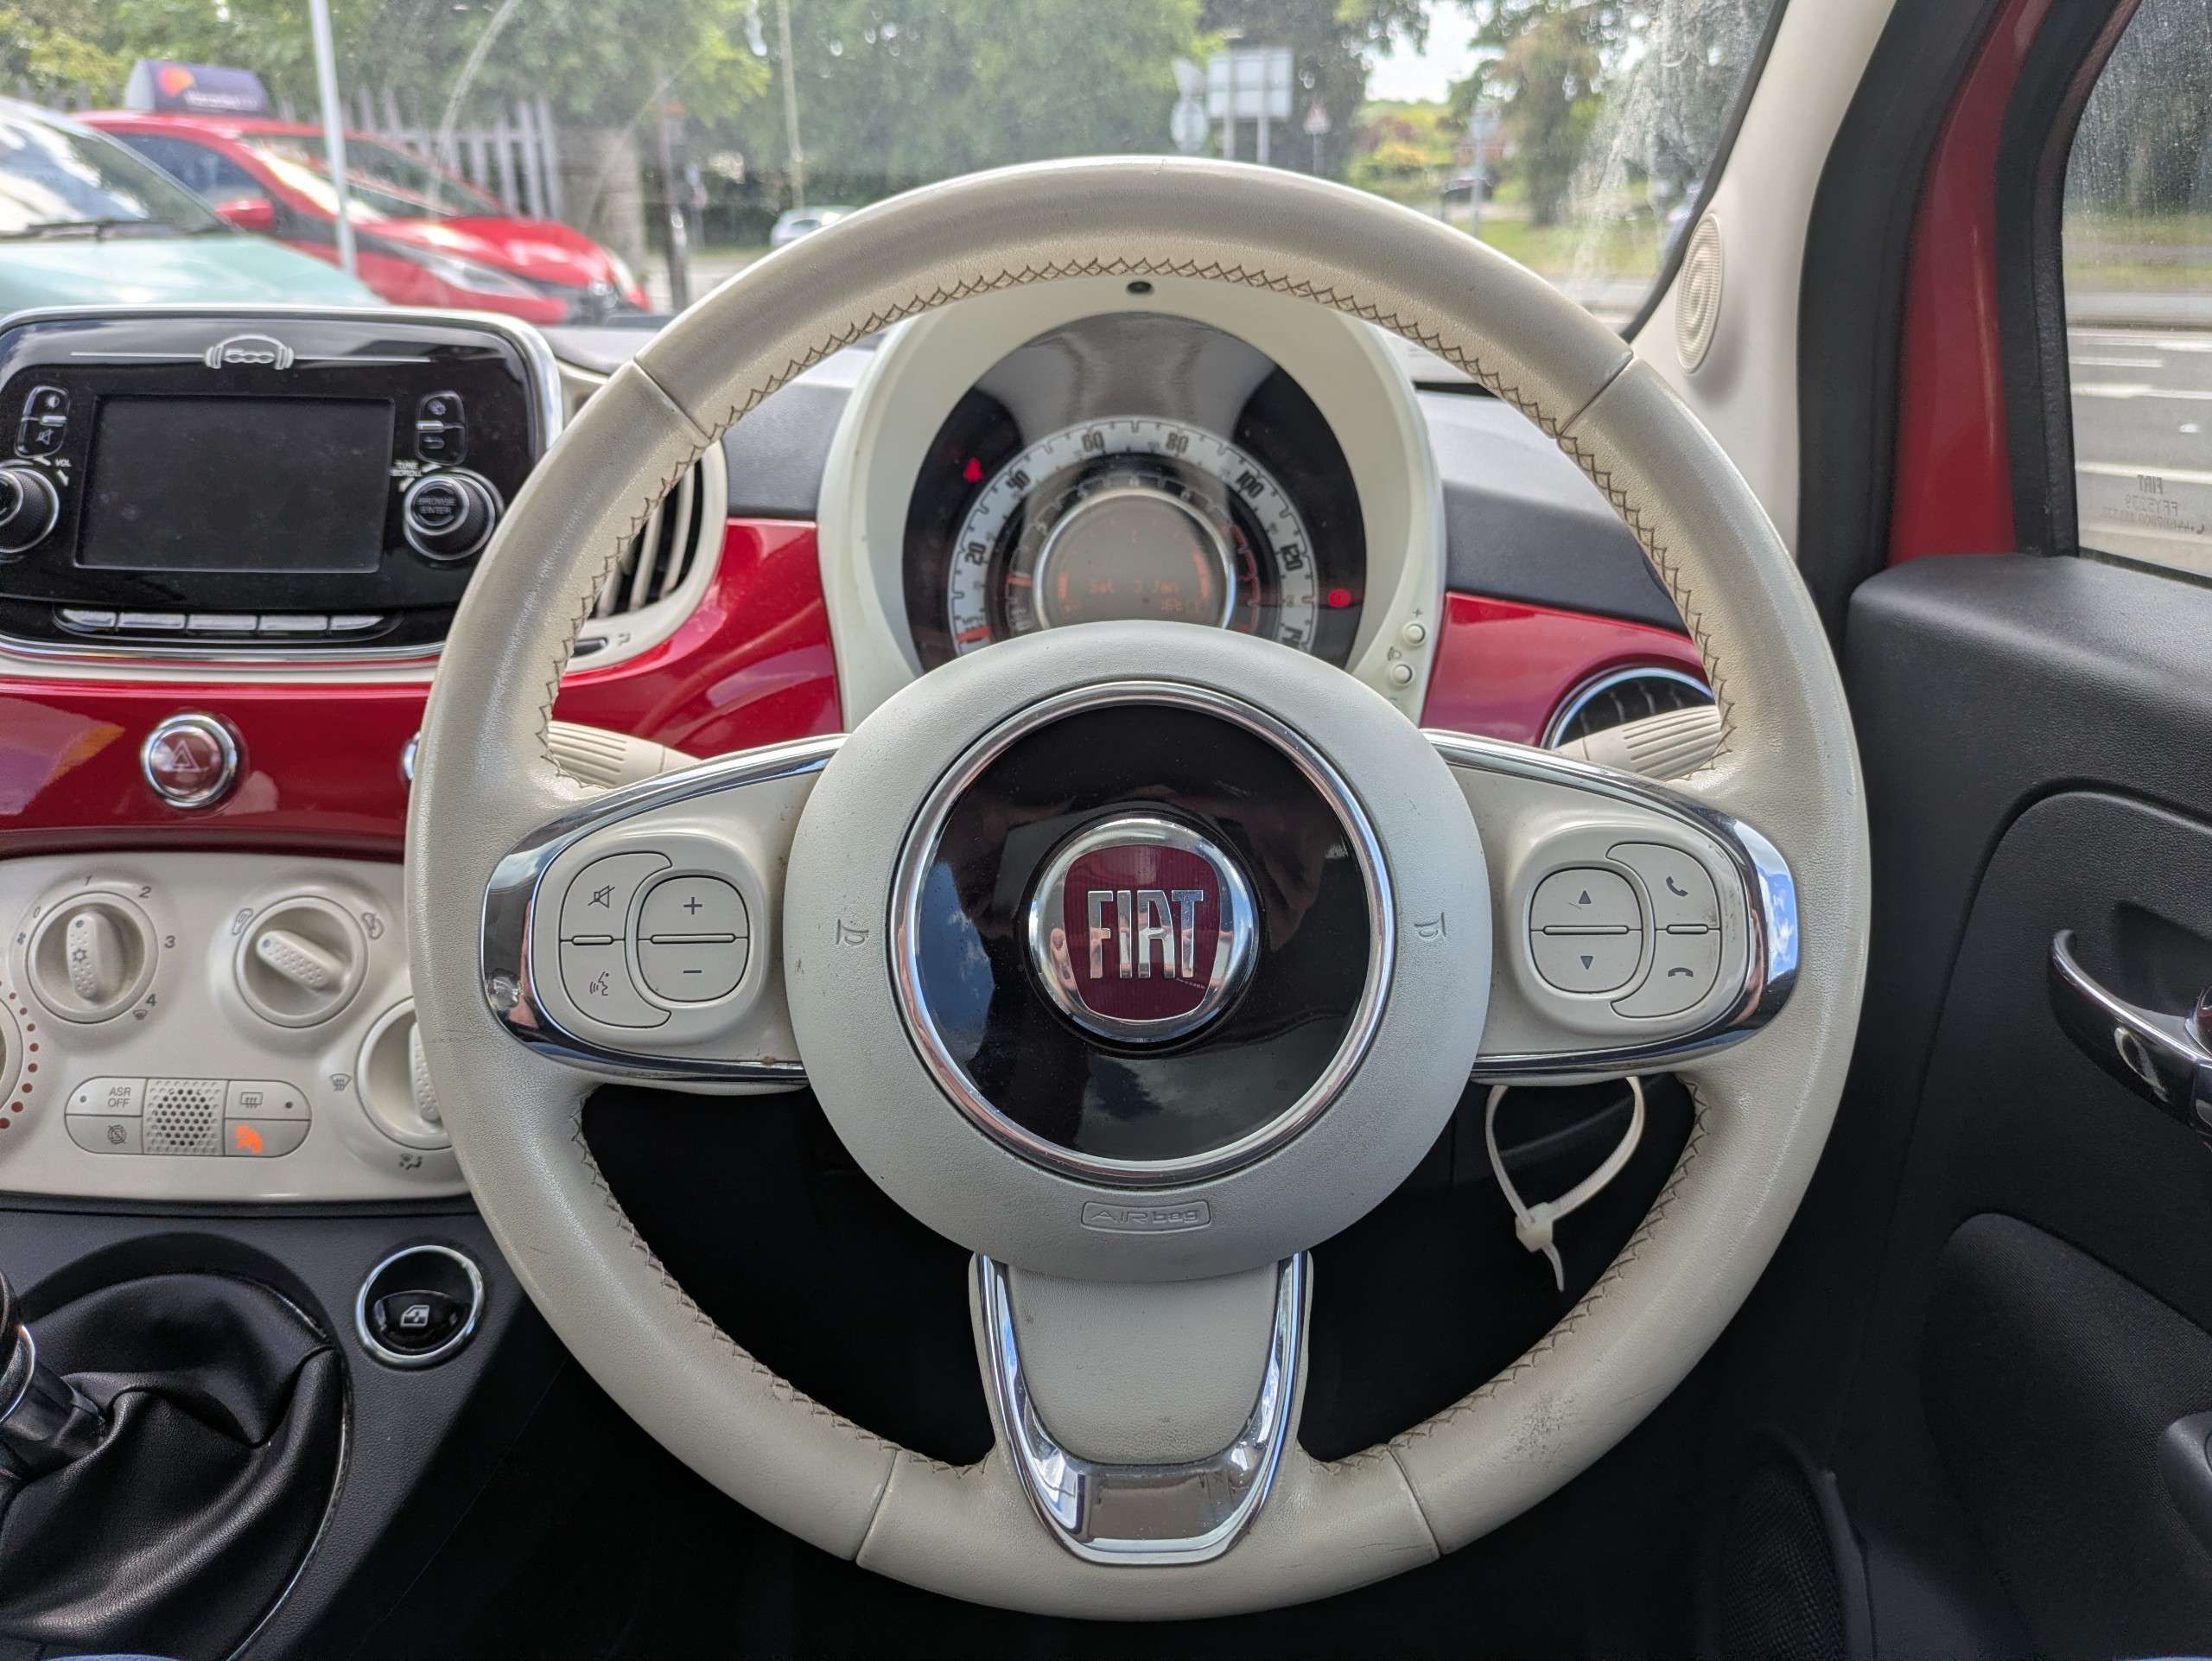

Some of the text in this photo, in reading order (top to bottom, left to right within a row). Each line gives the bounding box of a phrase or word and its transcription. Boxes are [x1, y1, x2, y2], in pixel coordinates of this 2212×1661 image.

[1082, 430, 1105, 452] 60
[1166, 432, 1189, 453] 80
[54, 459, 72, 468] VOL
[1006, 469, 1031, 492] 40
[1236, 471, 1264, 499] 100
[965, 542, 986, 565] 20
[1281, 544, 1303, 571] 120
[86, 875, 93, 886] 1
[139, 886, 151, 899] 2
[165, 935, 175, 948] 3
[1088, 889, 1204, 979] FIAT
[146, 994, 156, 1006] 4
[109, 1086, 131, 1097] ASR
[108, 1098, 131, 1107] OFF
